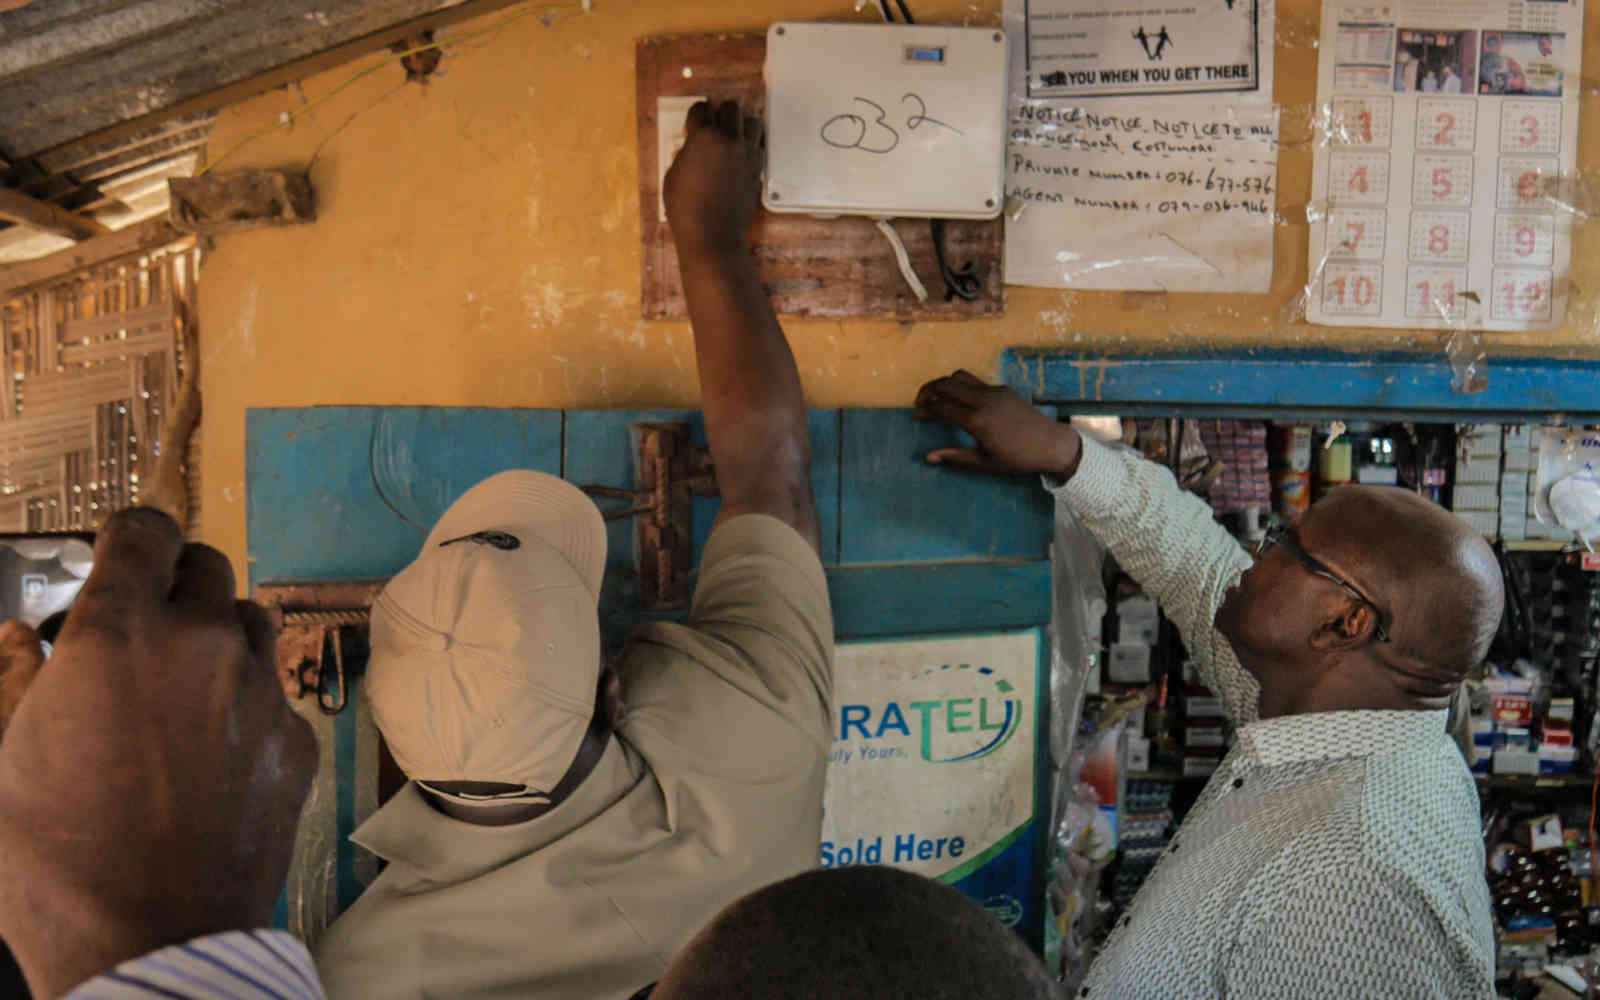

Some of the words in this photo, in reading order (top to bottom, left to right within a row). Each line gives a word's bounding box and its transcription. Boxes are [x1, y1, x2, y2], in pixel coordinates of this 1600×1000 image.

[1069, 71, 1096, 85] YOU
[1100, 69, 1139, 84] WHEN
[1143, 67, 1170, 82] YOU
[1175, 66, 1202, 80] GET
[1205, 64, 1249, 79] THERE
[821, 93, 965, 154] 032
[1357, 111, 1373, 142] 1
[1434, 113, 1456, 144] 2
[1519, 115, 1540, 146] 3
[1348, 167, 1369, 194] 4
[1431, 168, 1453, 198] 5
[1516, 172, 1540, 201] 6
[1345, 223, 1365, 252] 7
[1429, 225, 1449, 255] 8
[1514, 226, 1536, 257] 9
[1331, 277, 1375, 307] 10
[1416, 281, 1456, 310] 11
[1501, 282, 1542, 313] 12
[832, 697, 1005, 761] RATEL
[820, 836, 883, 868] Sold
[892, 831, 966, 864] Here
